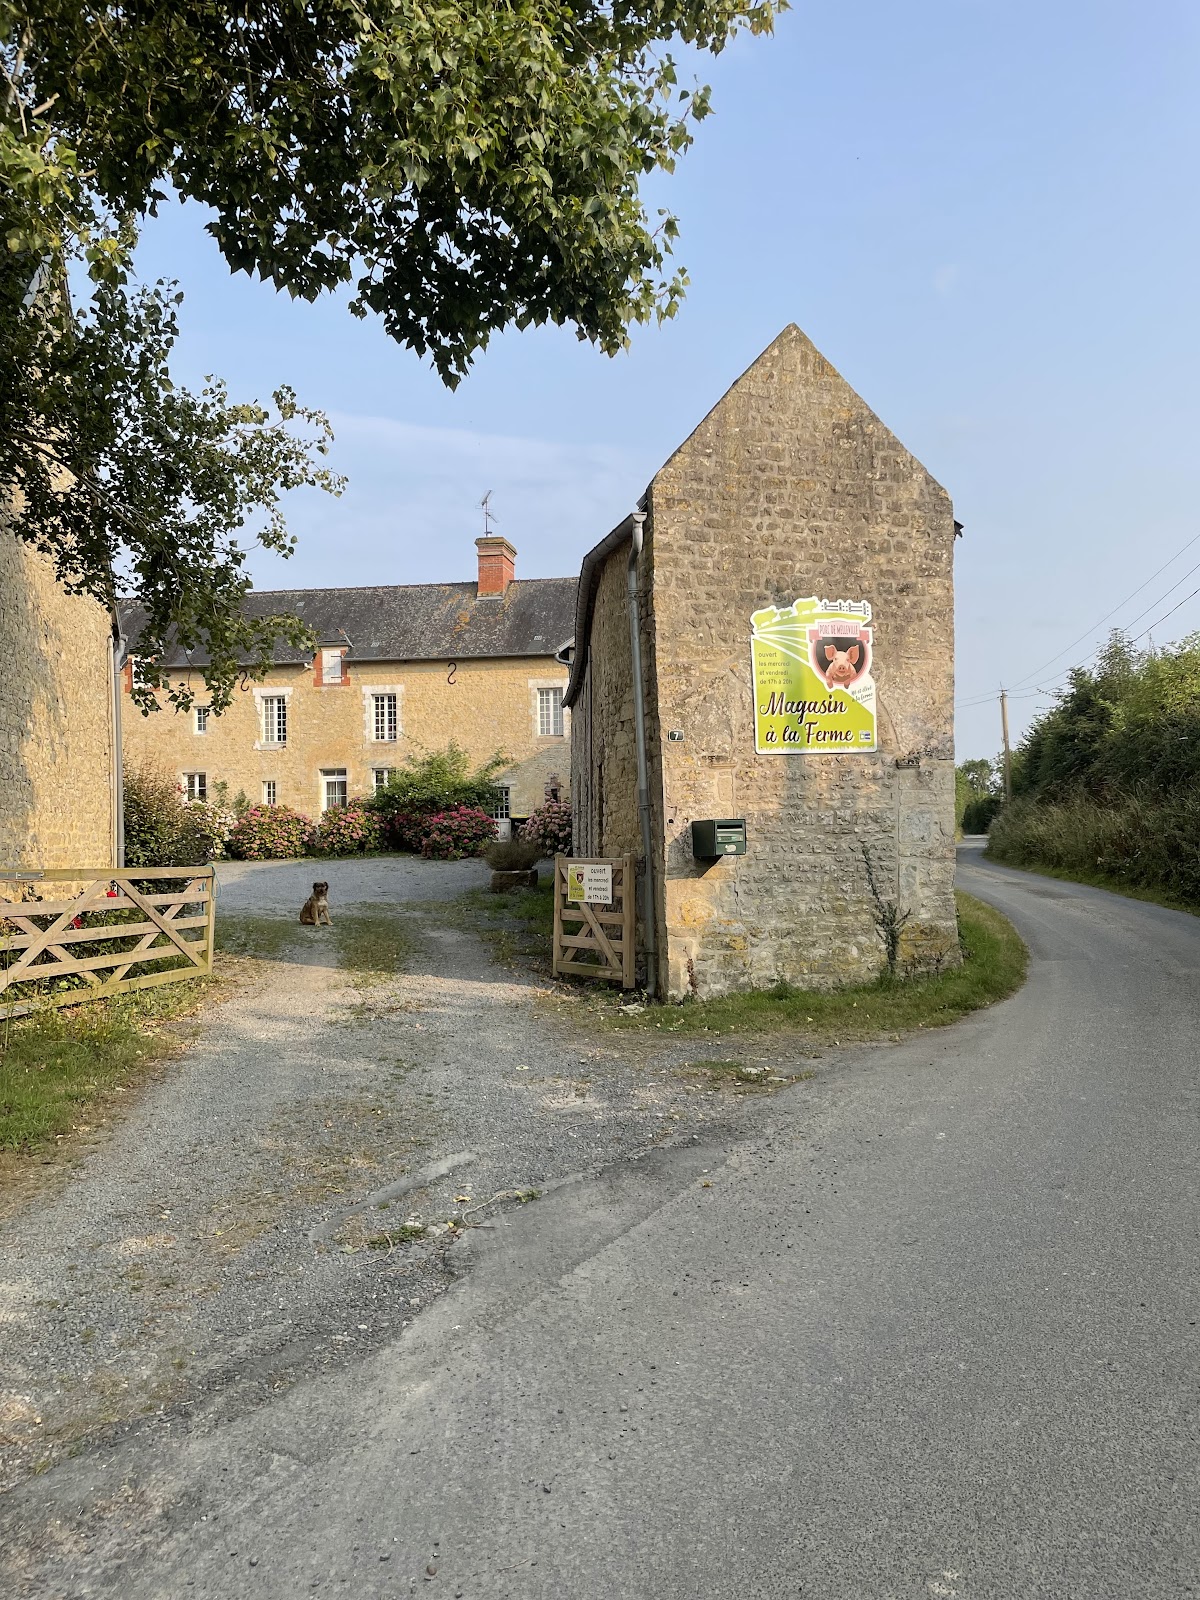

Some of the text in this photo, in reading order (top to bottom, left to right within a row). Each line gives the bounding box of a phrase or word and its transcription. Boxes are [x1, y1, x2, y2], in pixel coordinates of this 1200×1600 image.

[760, 691, 848, 724] Magasin
[673, 732, 679, 740] 7
[765, 724, 777, 743] à
[782, 725, 800, 743] la
[804, 721, 854, 744] Ferme
